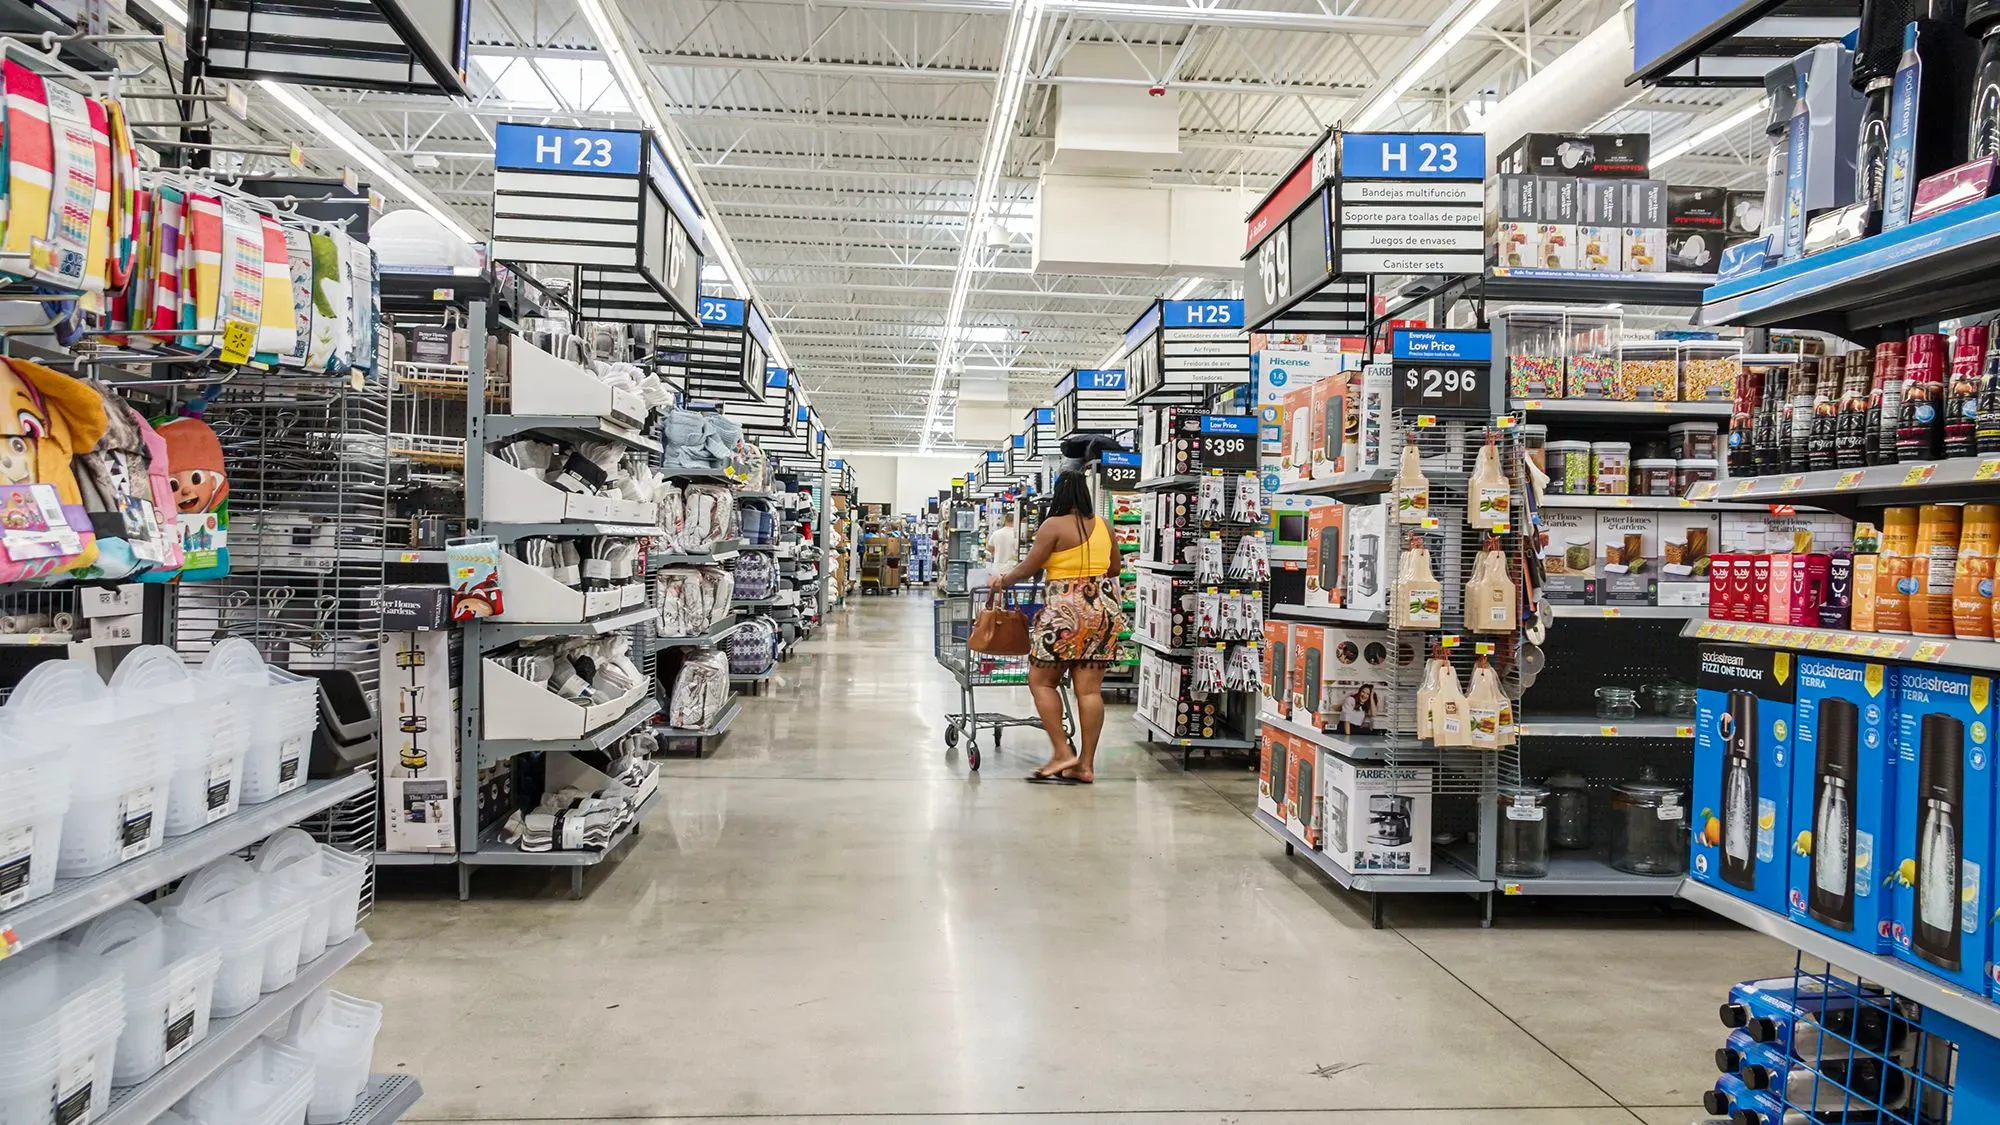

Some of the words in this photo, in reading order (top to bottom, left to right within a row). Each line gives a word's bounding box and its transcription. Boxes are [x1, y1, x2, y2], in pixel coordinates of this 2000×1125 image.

[1902, 69, 1914, 137] sodastream
[535, 135, 562, 164] H
[572, 138, 612, 167] 23
[1796, 116, 1805, 177] sodastream
[1382, 143, 1406, 171] H
[1418, 143, 1458, 172] 23
[1362, 188, 1403, 199] Bandejas
[1406, 188, 1466, 198] multifunción
[1345, 212, 1383, 224] Soporte
[1385, 213, 1406, 224] para
[1408, 212, 1439, 222] toallas
[1441, 212, 1453, 222] de
[1455, 212, 1481, 225] papel
[1370, 236, 1403, 248] Juegos
[1406, 236, 1417, 245] de
[1259, 230, 1289, 305] $69
[1383, 260, 1423, 269] Canister
[1425, 261, 1444, 269] sets
[702, 303, 727, 320] 25
[1409, 332, 1436, 340] Everyday
[224, 345, 247, 359] Clearance
[1409, 341, 1430, 351] Low
[1431, 341, 1456, 351] Price
[1269, 357, 1311, 367] Hisense
[1273, 372, 1284, 380] 1.6
[1764, 517, 1785, 525] Better
[1786, 518, 1812, 526] Homes
[394, 600, 421, 608] Homes
[1702, 651, 1744, 666] sodastream
[1702, 662, 1719, 674] FIZZI
[1721, 664, 1736, 677] ONE
[1736, 667, 1763, 681] TOUCH
[1801, 662, 1863, 682] sodastream
[1801, 676, 1826, 688] TERRA
[1902, 673, 1968, 696] sodastream
[1902, 689, 1930, 703] TERRA
